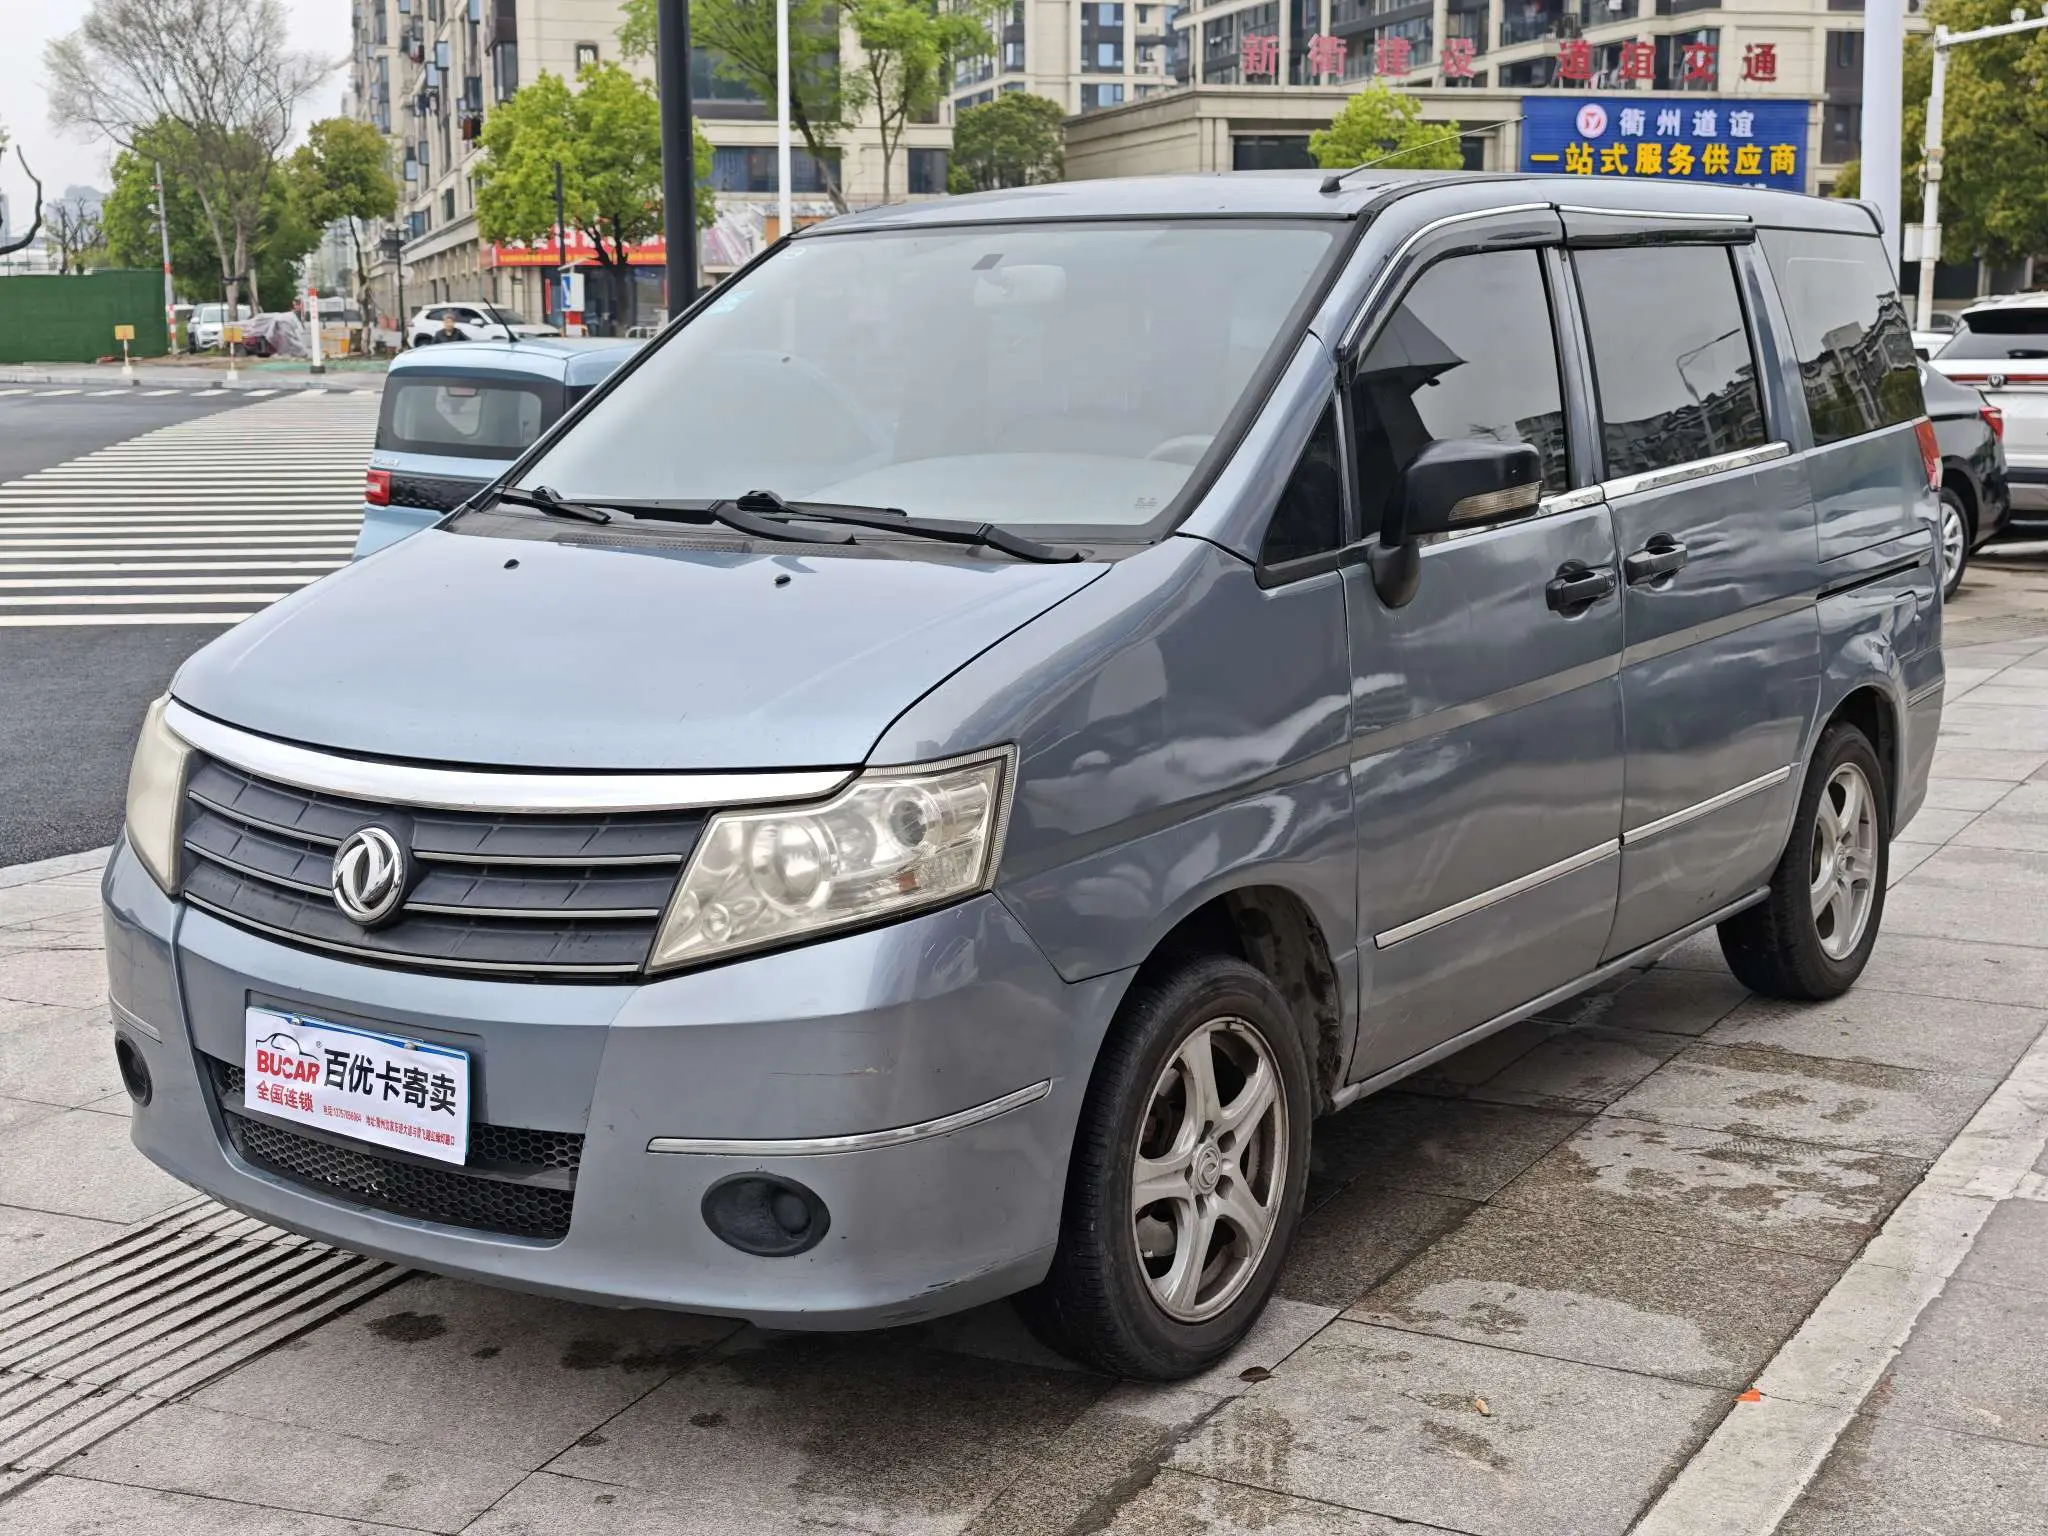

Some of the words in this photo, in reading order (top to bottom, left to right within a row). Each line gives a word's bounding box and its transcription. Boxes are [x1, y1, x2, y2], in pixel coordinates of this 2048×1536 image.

[1242, 32, 1477, 78] 新衢建设
[1556, 39, 1777, 82] 道谊交通
[1619, 107, 1754, 138] 衢州道谊
[1531, 142, 1797, 175] 一站式服务供应商
[256, 1049, 320, 1084] BUCAR
[323, 1048, 456, 1117] 百优卡寄卖
[256, 1080, 314, 1113] 全国连锁
